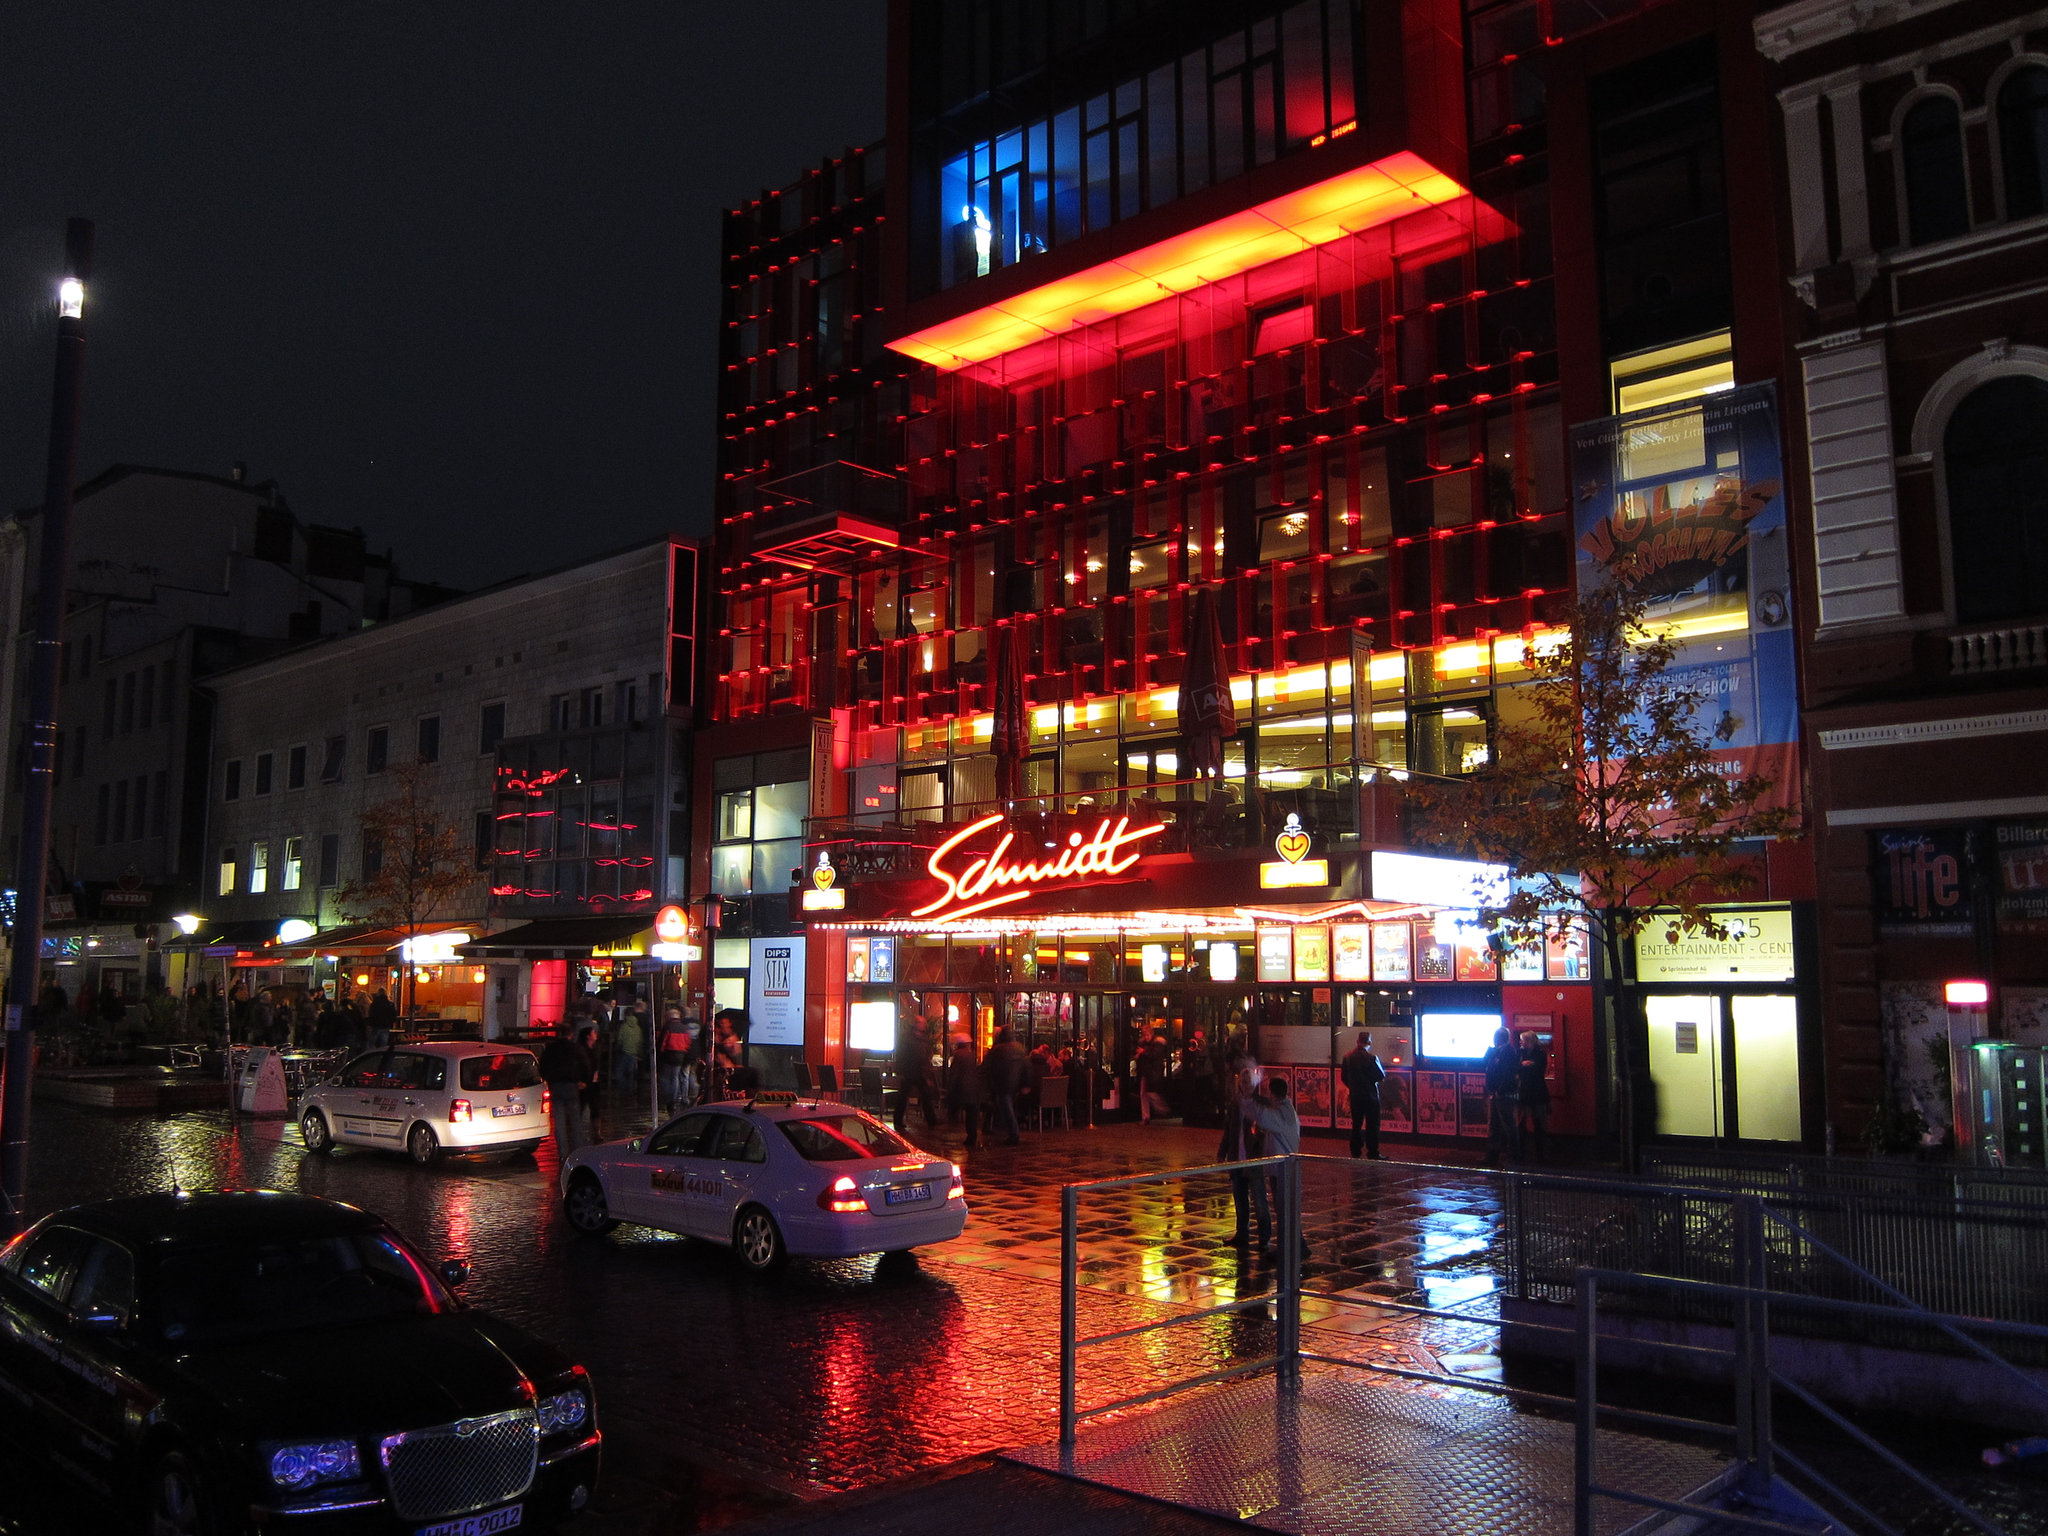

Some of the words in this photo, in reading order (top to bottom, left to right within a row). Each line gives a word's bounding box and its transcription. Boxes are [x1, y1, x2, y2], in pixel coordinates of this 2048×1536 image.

[1576, 439, 1594, 449] Von
[1724, 400, 1769, 418] Lingnau
[1578, 478, 1782, 563] VOLLES
[1610, 526, 1749, 589] PROGRAMM!
[911, 814, 1165, 917] Schmidt
[1889, 843, 1960, 919] life
[106, 893, 147, 903] ASTRA
[1641, 943, 1745, 956] ENTERTAINMENT
[687, 1178, 722, 1197] 441011
[479, 1507, 520, 1535] 9012
